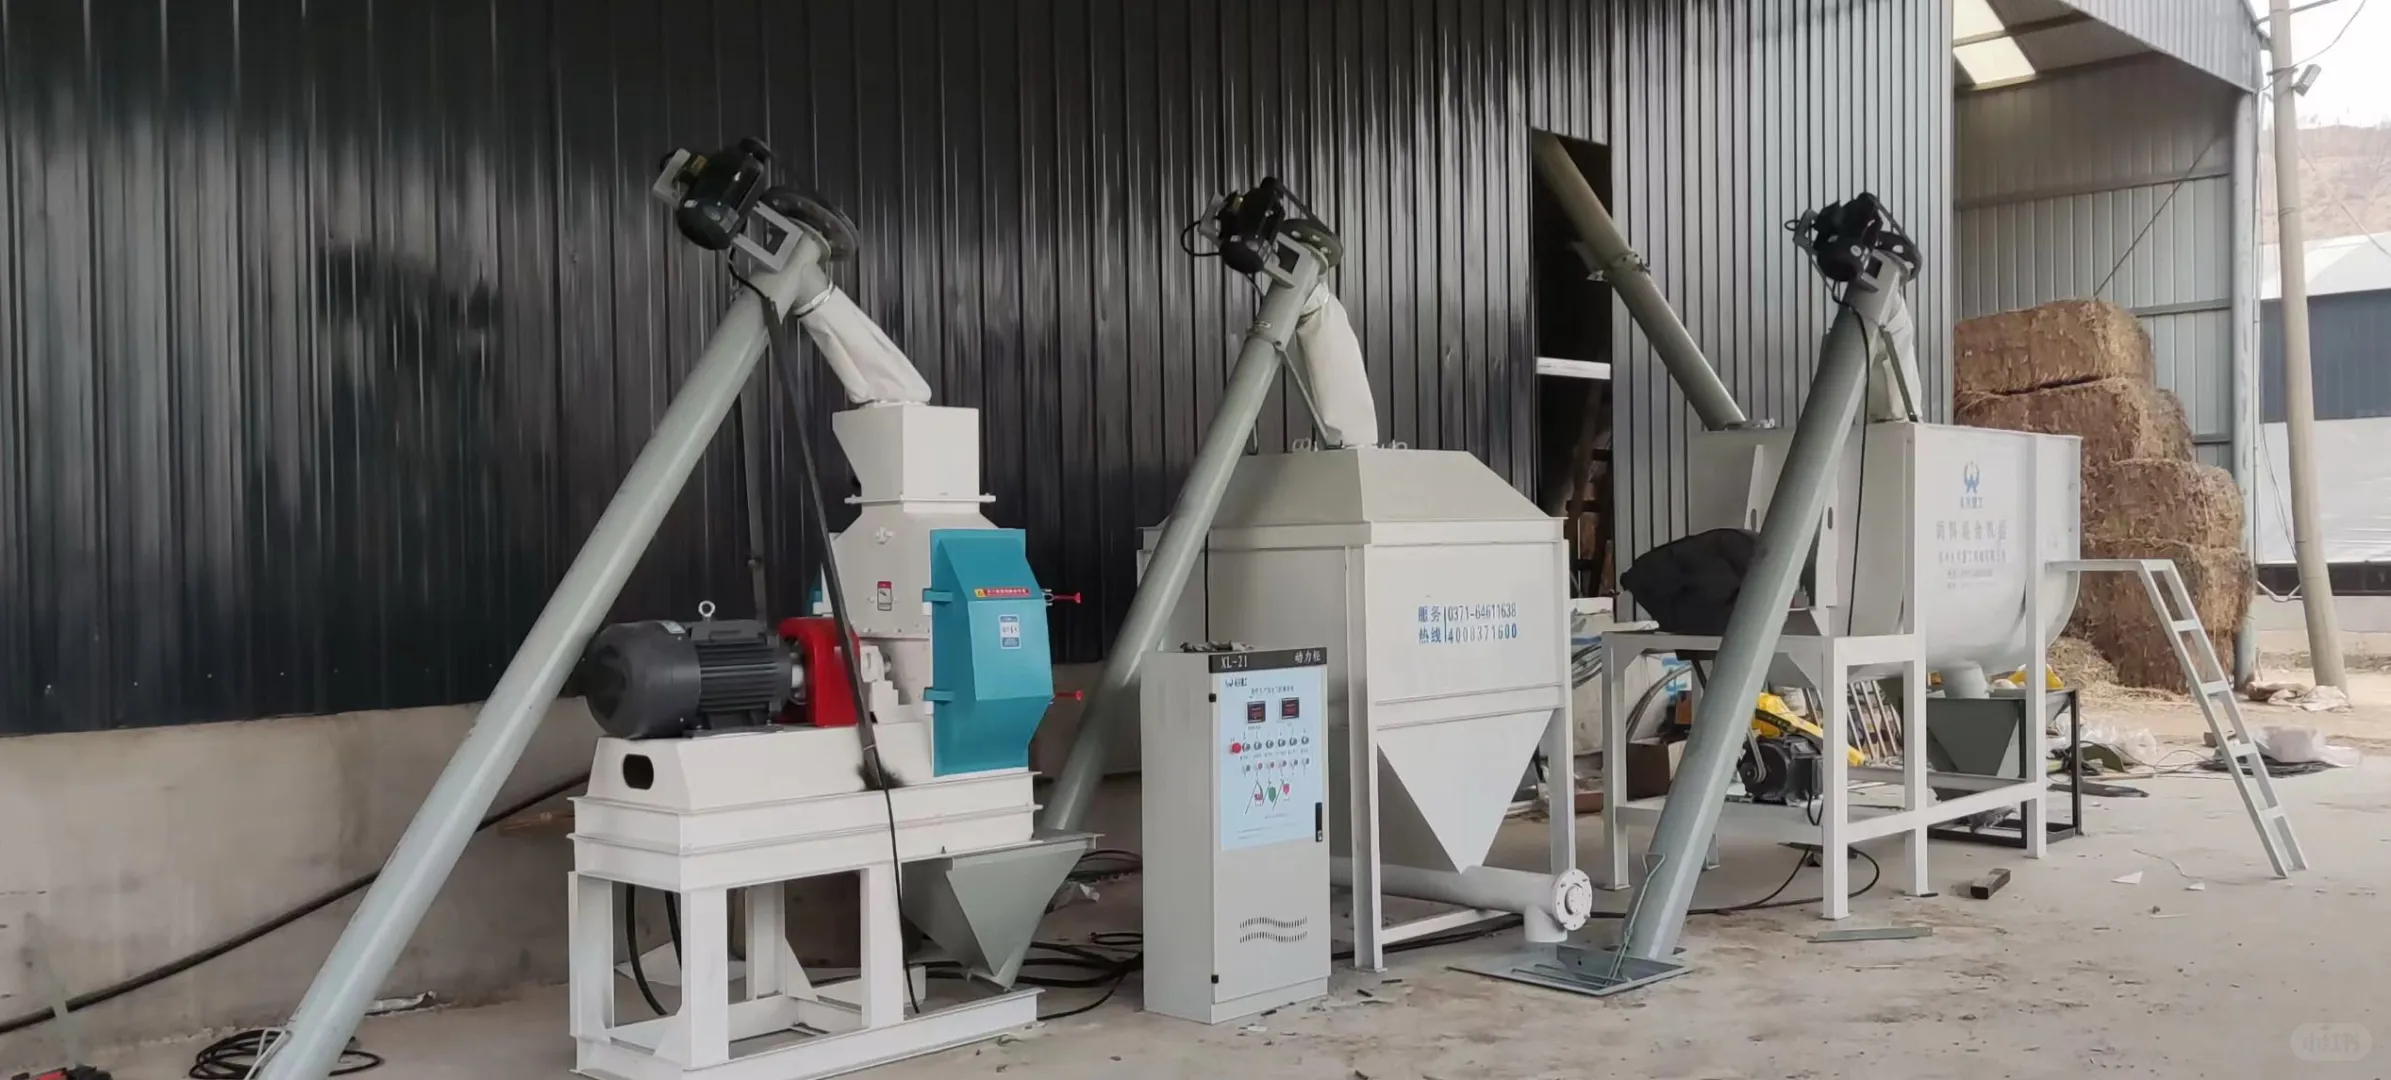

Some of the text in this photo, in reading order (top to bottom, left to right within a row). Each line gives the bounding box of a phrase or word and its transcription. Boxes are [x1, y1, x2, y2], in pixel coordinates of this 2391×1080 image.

[1418, 605, 1441, 622] 服务
[1419, 626, 1441, 644] 热线
[1221, 655, 1247, 668] XL-21
[1294, 649, 1321, 664] 动力柜
